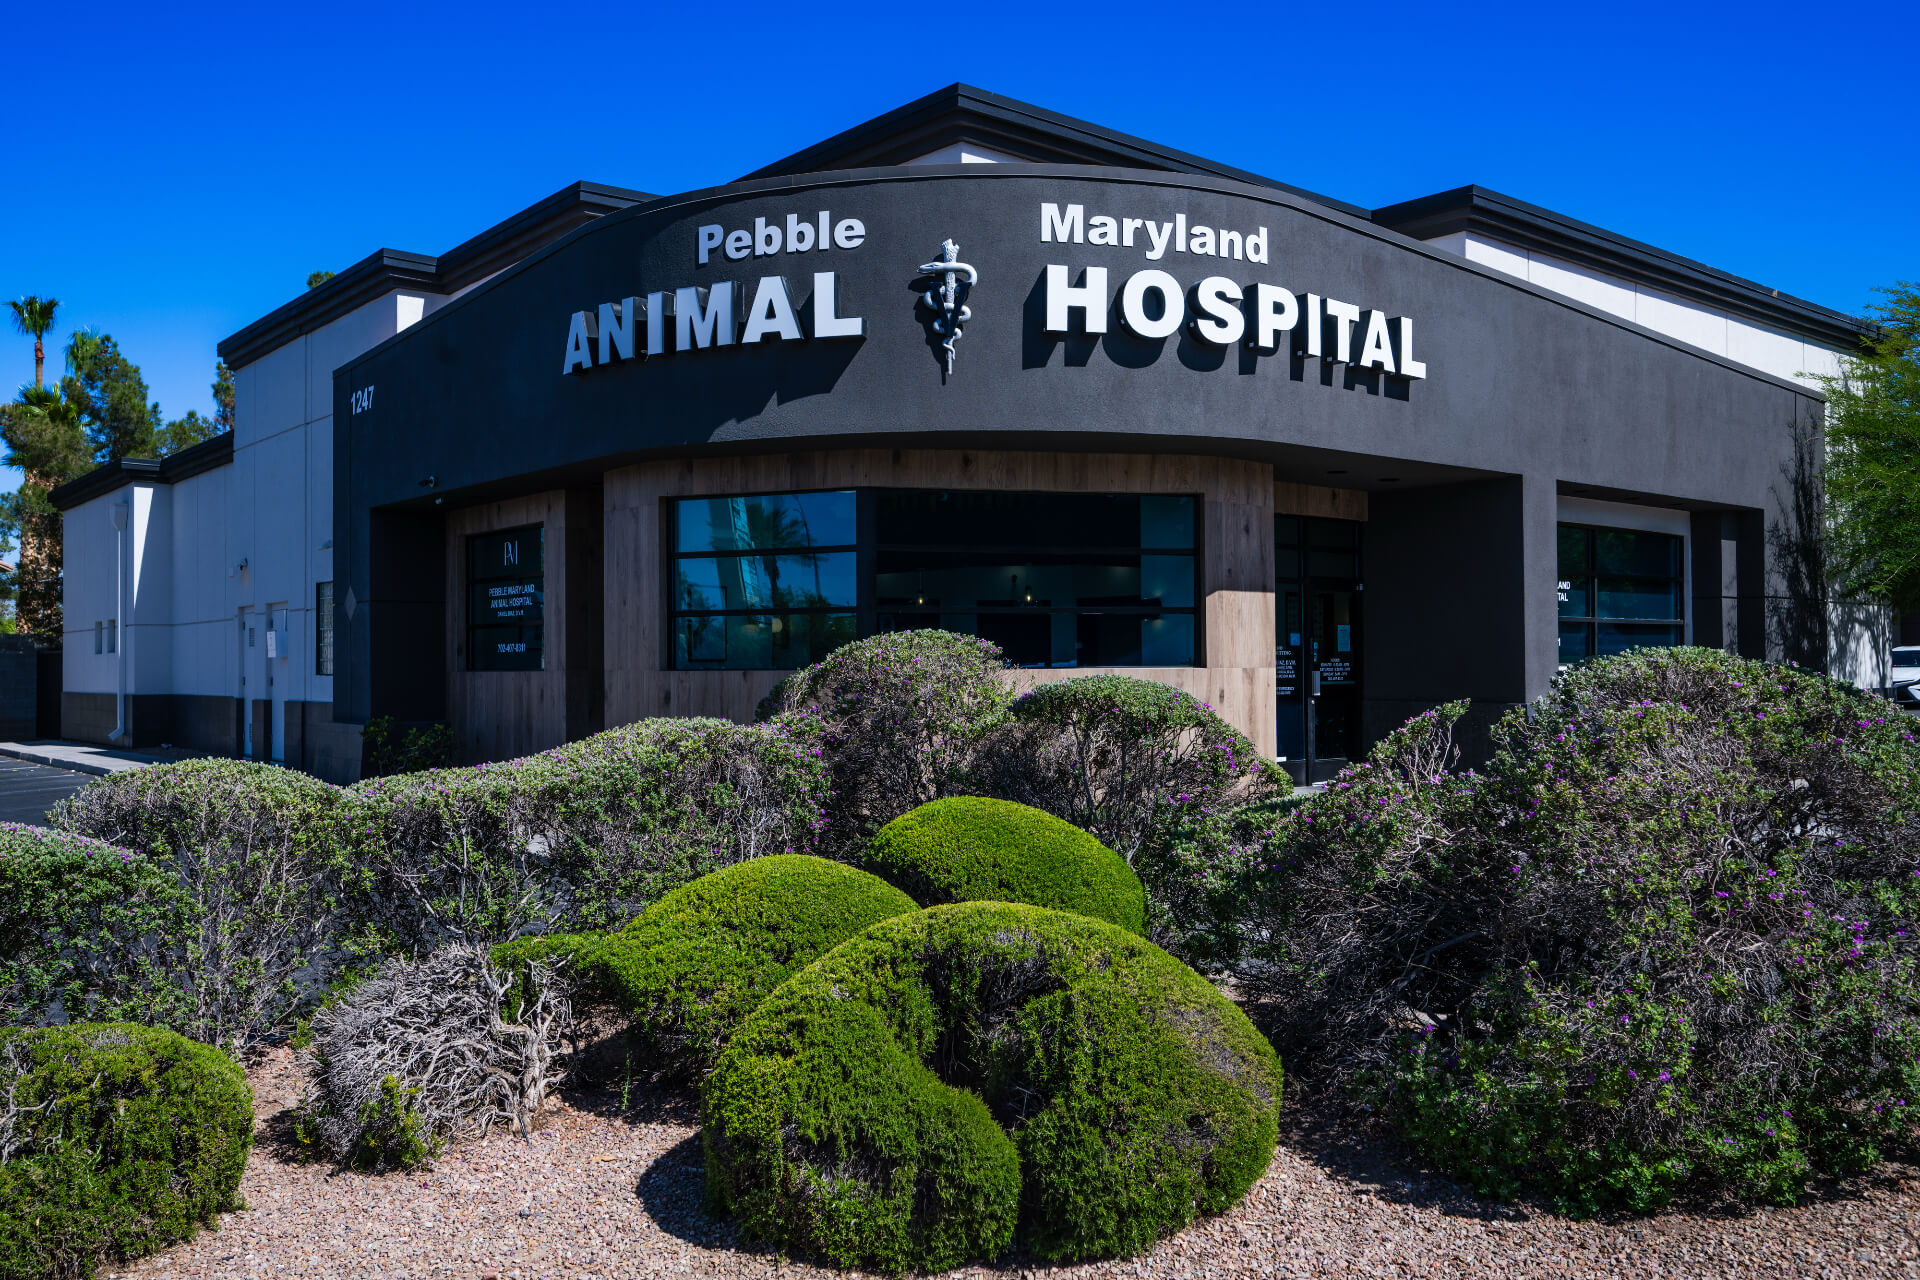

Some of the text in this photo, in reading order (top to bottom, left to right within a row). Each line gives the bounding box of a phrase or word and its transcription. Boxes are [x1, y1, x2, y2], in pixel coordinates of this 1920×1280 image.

[698, 202, 1269, 265] Pebble Maryland
[563, 264, 1427, 380] ANIMAL HOSPITAL
[351, 384, 375, 416] 1247
[488, 584, 535, 598] PEBBLE MARYLAND
[490, 597, 533, 609] ANIMAL HOSPITAL
